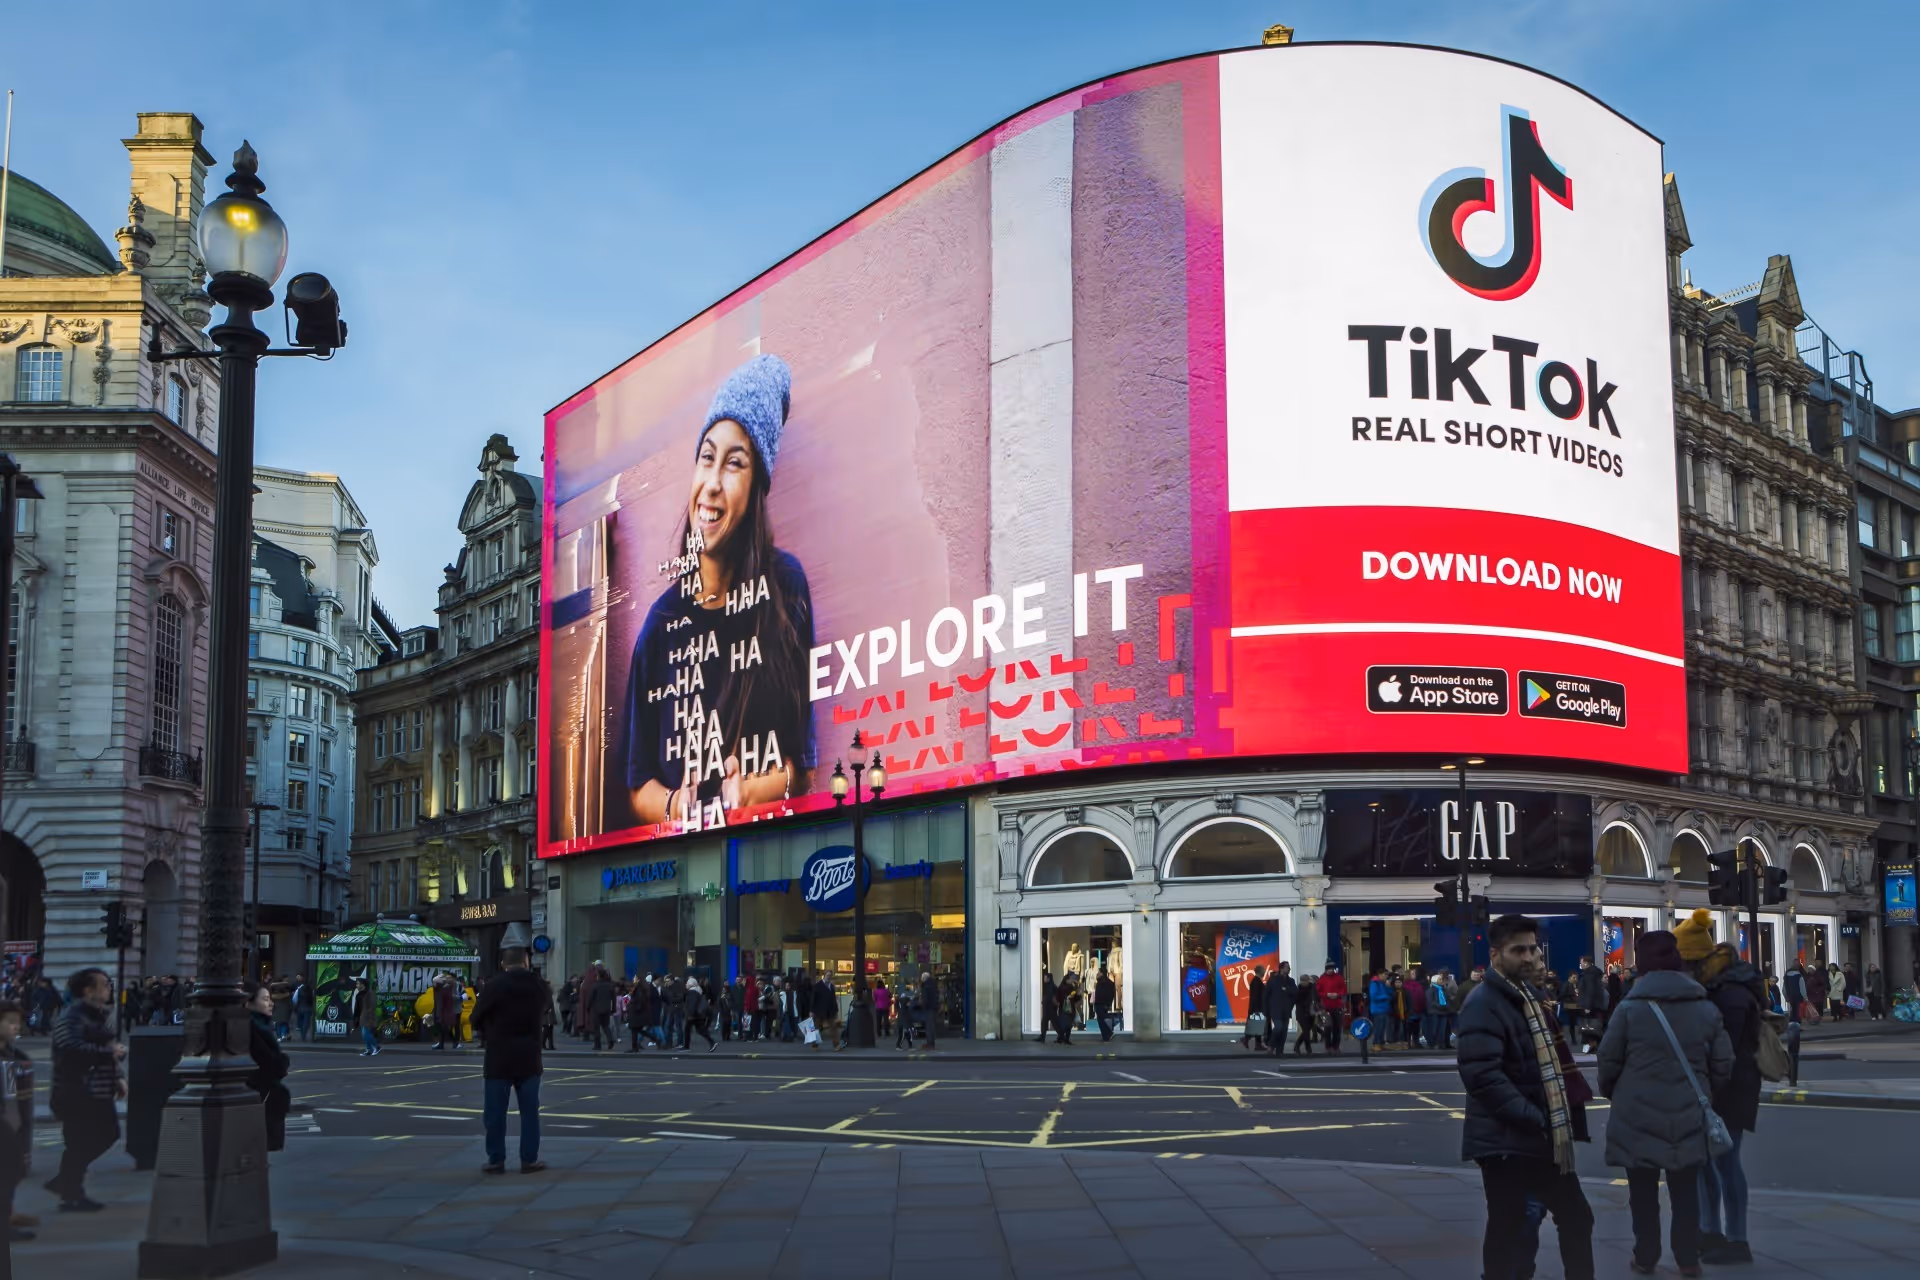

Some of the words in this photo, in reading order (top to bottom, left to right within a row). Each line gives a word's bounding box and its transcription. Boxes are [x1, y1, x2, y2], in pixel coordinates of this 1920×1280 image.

[1347, 324, 1622, 439] TikTok
[1351, 416, 1436, 443] REAL
[1444, 419, 1542, 455] SHORT
[1547, 433, 1624, 478] VIDEOS
[140, 461, 170, 490] ALLIANCE
[174, 484, 187, 502] LIFE
[191, 496, 210, 517] OFFICE
[681, 572, 703, 599] HA
[1361, 550, 1561, 591] DOWNLOAD
[1568, 566, 1622, 604] NOW
[740, 575, 770, 610] HA
[666, 615, 692, 632] HA
[809, 580, 1047, 702] EXPLORE
[1073, 563, 1144, 637] IT
[668, 644, 697, 665] HA
[690, 630, 720, 666] HA
[730, 635, 763, 673] HA
[647, 683, 678, 703] HA
[675, 662, 705, 697] HA
[1410, 675, 1461, 685] Download
[1463, 677, 1476, 686] on
[1477, 677, 1494, 686] the
[1555, 680, 1572, 691] GET
[1572, 682, 1579, 692] IT
[1579, 683, 1591, 693] ON
[1409, 686, 1449, 707] App
[1451, 686, 1500, 706] Store
[1556, 692, 1600, 717] Google
[1600, 698, 1622, 722] Play
[673, 693, 706, 731] HA
[685, 737, 726, 785] HA
[741, 729, 783, 777] HA
[1440, 799, 1516, 861] GAP
[615, 860, 677, 885] BARCLAYS
[805, 855, 856, 902] Boots
[460, 905, 482, 920] JEWEL
[482, 903, 497, 918] BAR
[997, 932, 1007, 941] GAP
[1226, 937, 1251, 950] GAP
[1229, 928, 1266, 944] GREAT
[1842, 926, 1853, 934] GAP
[1223, 946, 1254, 961] SALE
[1223, 967, 1235, 977] UP
[1237, 964, 1248, 972] TO
